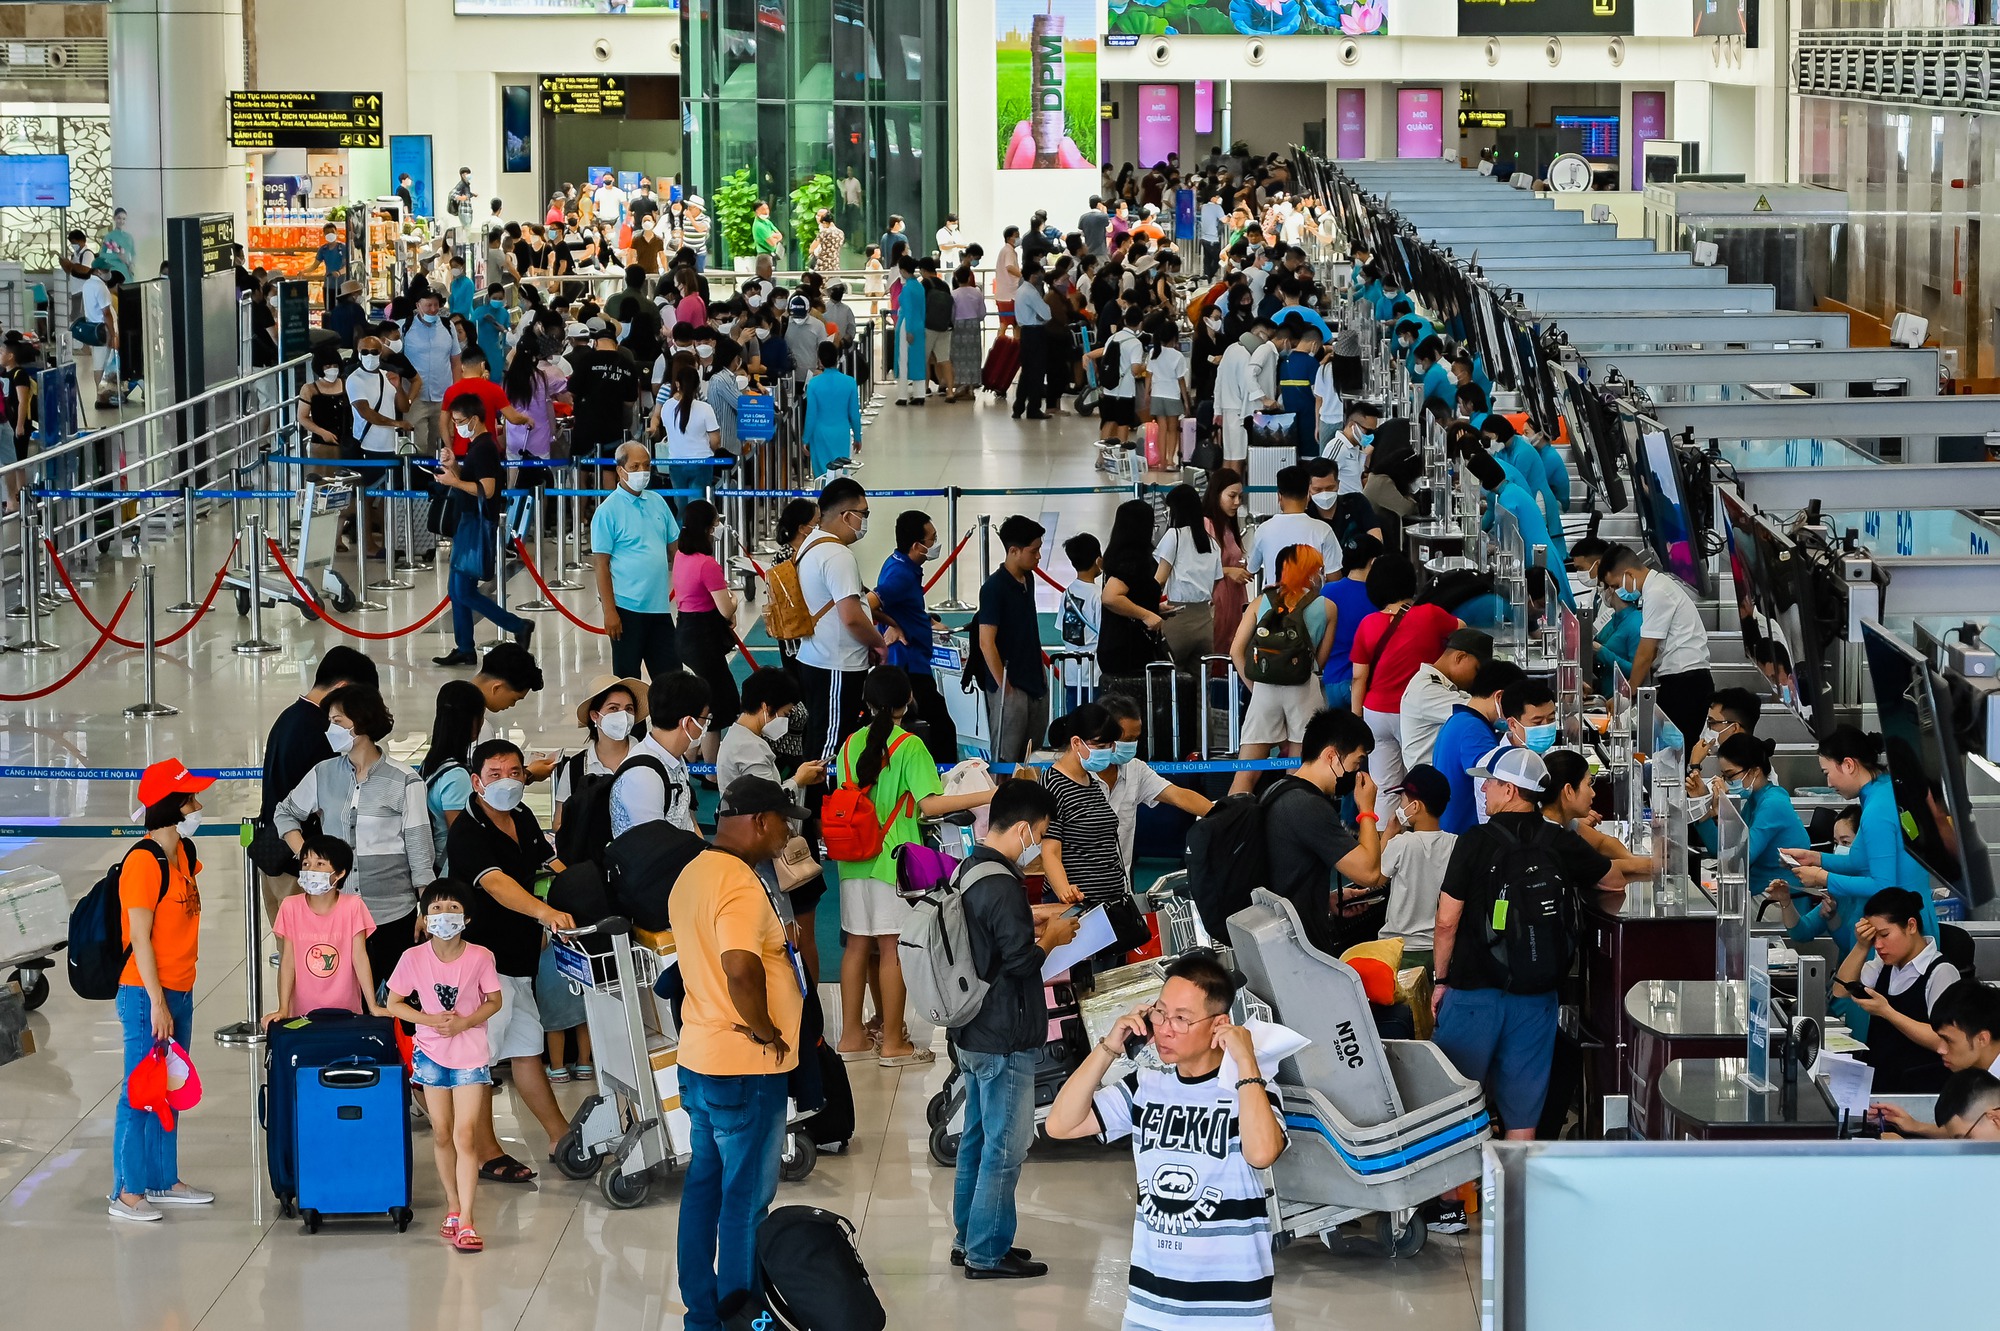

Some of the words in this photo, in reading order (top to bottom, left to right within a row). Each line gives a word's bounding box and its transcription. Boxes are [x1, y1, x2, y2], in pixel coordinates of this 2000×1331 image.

[1040, 36, 1062, 111] DPM
[271, 112, 280, 120] TẾ,
[1412, 110, 1427, 118] MỜI
[1406, 122, 1433, 131] QUẢNG
[264, 183, 287, 193] epsi
[1897, 510, 1912, 556] B25
[5, 768, 26, 776] CẢNG
[27, 768, 48, 776] HÀNG
[50, 768, 76, 777] KHÔNG
[78, 768, 99, 778] QUỐC
[100, 768, 109, 777] TẾ
[110, 770, 123, 778] NỘI
[692, 765, 712, 773] QUỐC
[1528, 925, 1539, 962] patagonia
[1336, 1020, 1364, 1069] NTOC
[1333, 1040, 1344, 1061] 2020
[1138, 1178, 1223, 1235] UNLIMITED
[1440, 1212, 1457, 1220] HOKA
[1158, 1239, 1172, 1250] 1972
[1175, 1241, 1183, 1250] EU
